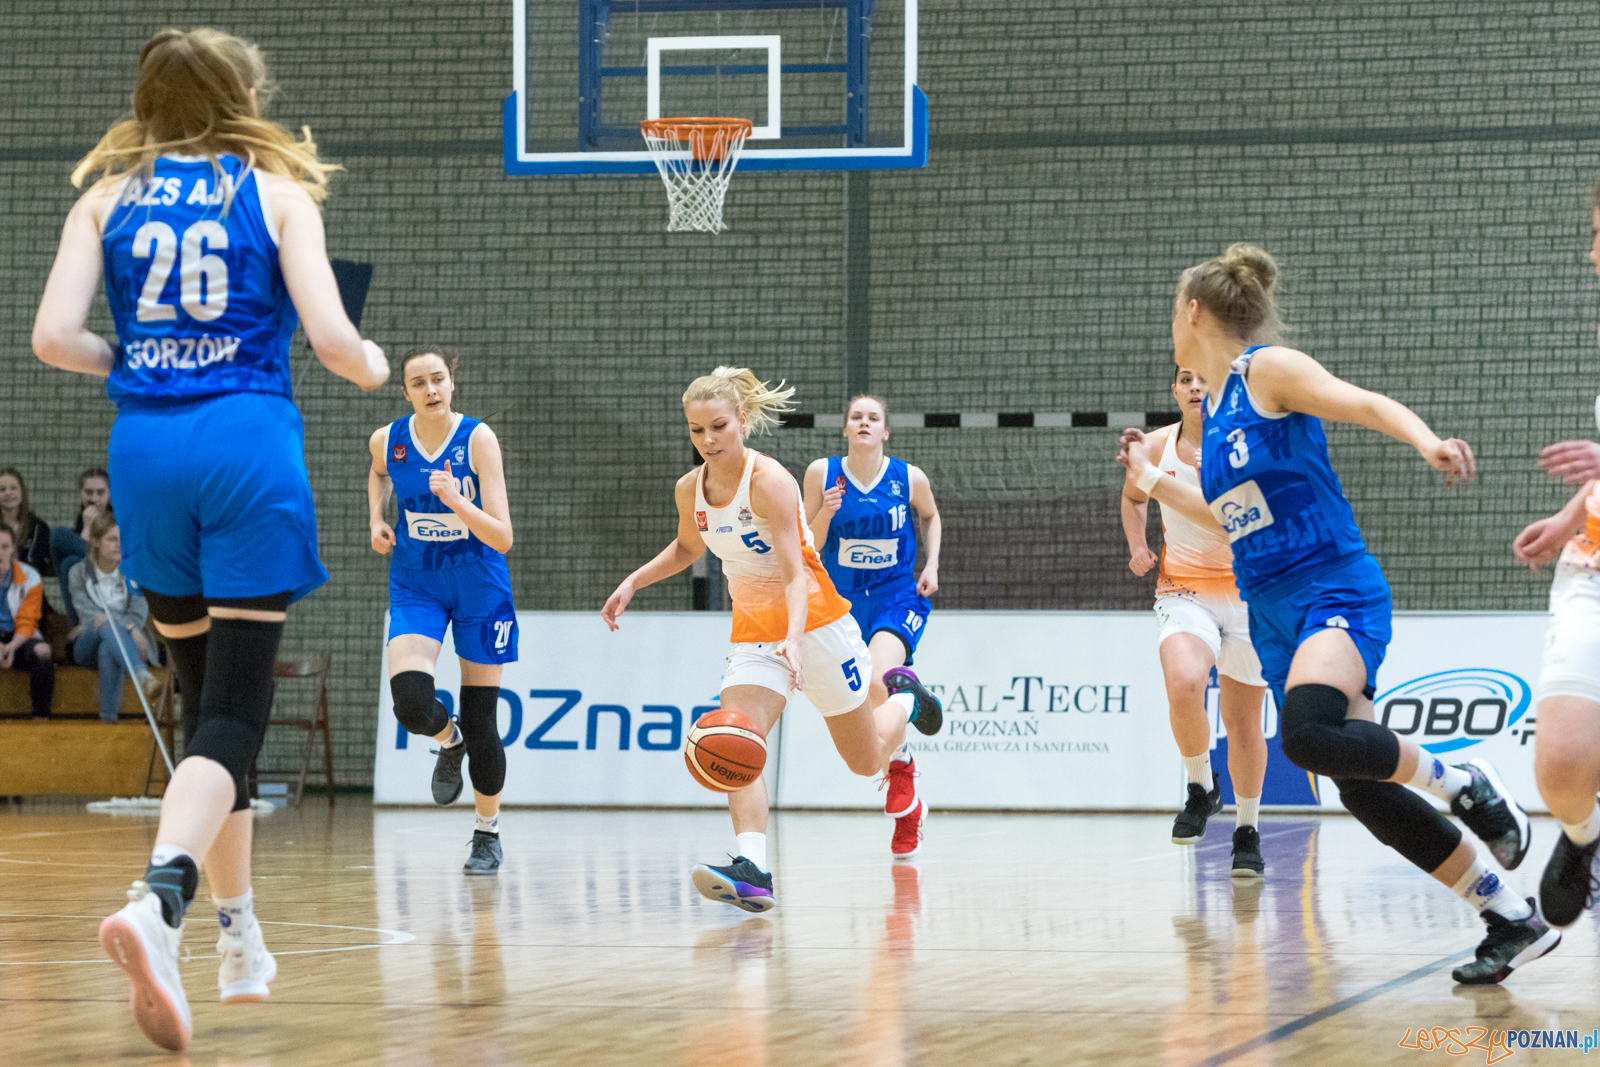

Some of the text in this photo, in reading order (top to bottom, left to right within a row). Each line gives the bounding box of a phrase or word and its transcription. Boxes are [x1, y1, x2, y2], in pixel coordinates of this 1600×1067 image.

[121, 176, 182, 207] AZS
[131, 219, 229, 322] 26
[1226, 427, 1250, 469] 3
[888, 503, 907, 532] 16
[417, 526, 462, 538] Enea
[740, 531, 772, 554] 5
[850, 551, 893, 564] Enea
[841, 657, 862, 692] 5
[949, 715, 1040, 737] POZNAŃ
[710, 761, 755, 782] molten
